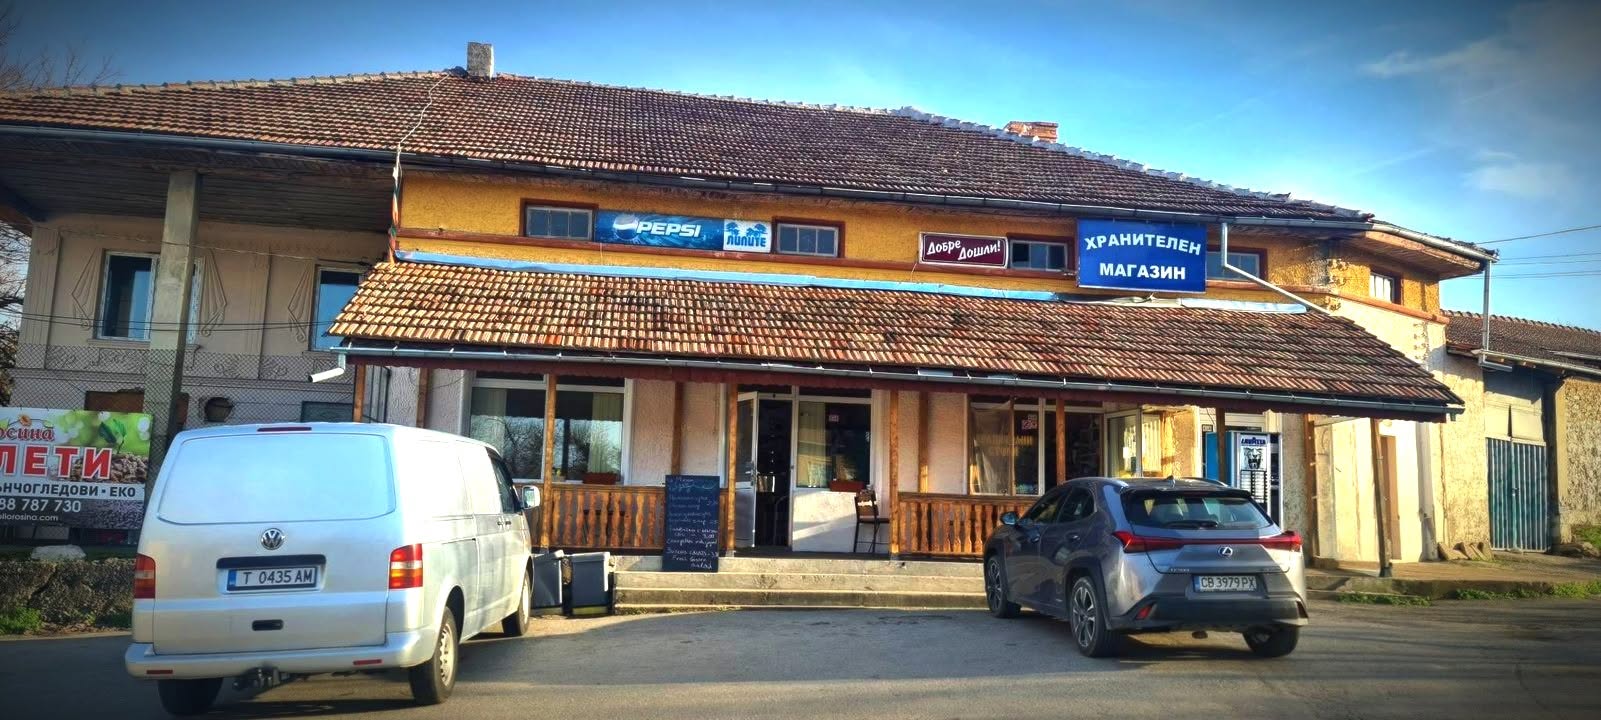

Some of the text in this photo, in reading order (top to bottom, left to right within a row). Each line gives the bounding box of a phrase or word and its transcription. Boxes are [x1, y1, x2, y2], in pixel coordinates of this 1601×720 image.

[636, 221, 702, 238] PEPSI
[957, 241, 1001, 261] Дошли!
[1084, 233, 1202, 256] ХРАНИТЕЛЕН
[1099, 262, 1186, 280] МАГАЗИН
[0, 482, 136, 497] НЧОГЛЕДОВИ ЕКО
[21, 498, 49, 512] 787
[54, 499, 82, 513] 730
[243, 569, 313, 585] T 0435 AM
[1201, 577, 1256, 588] CB 3979 PX
